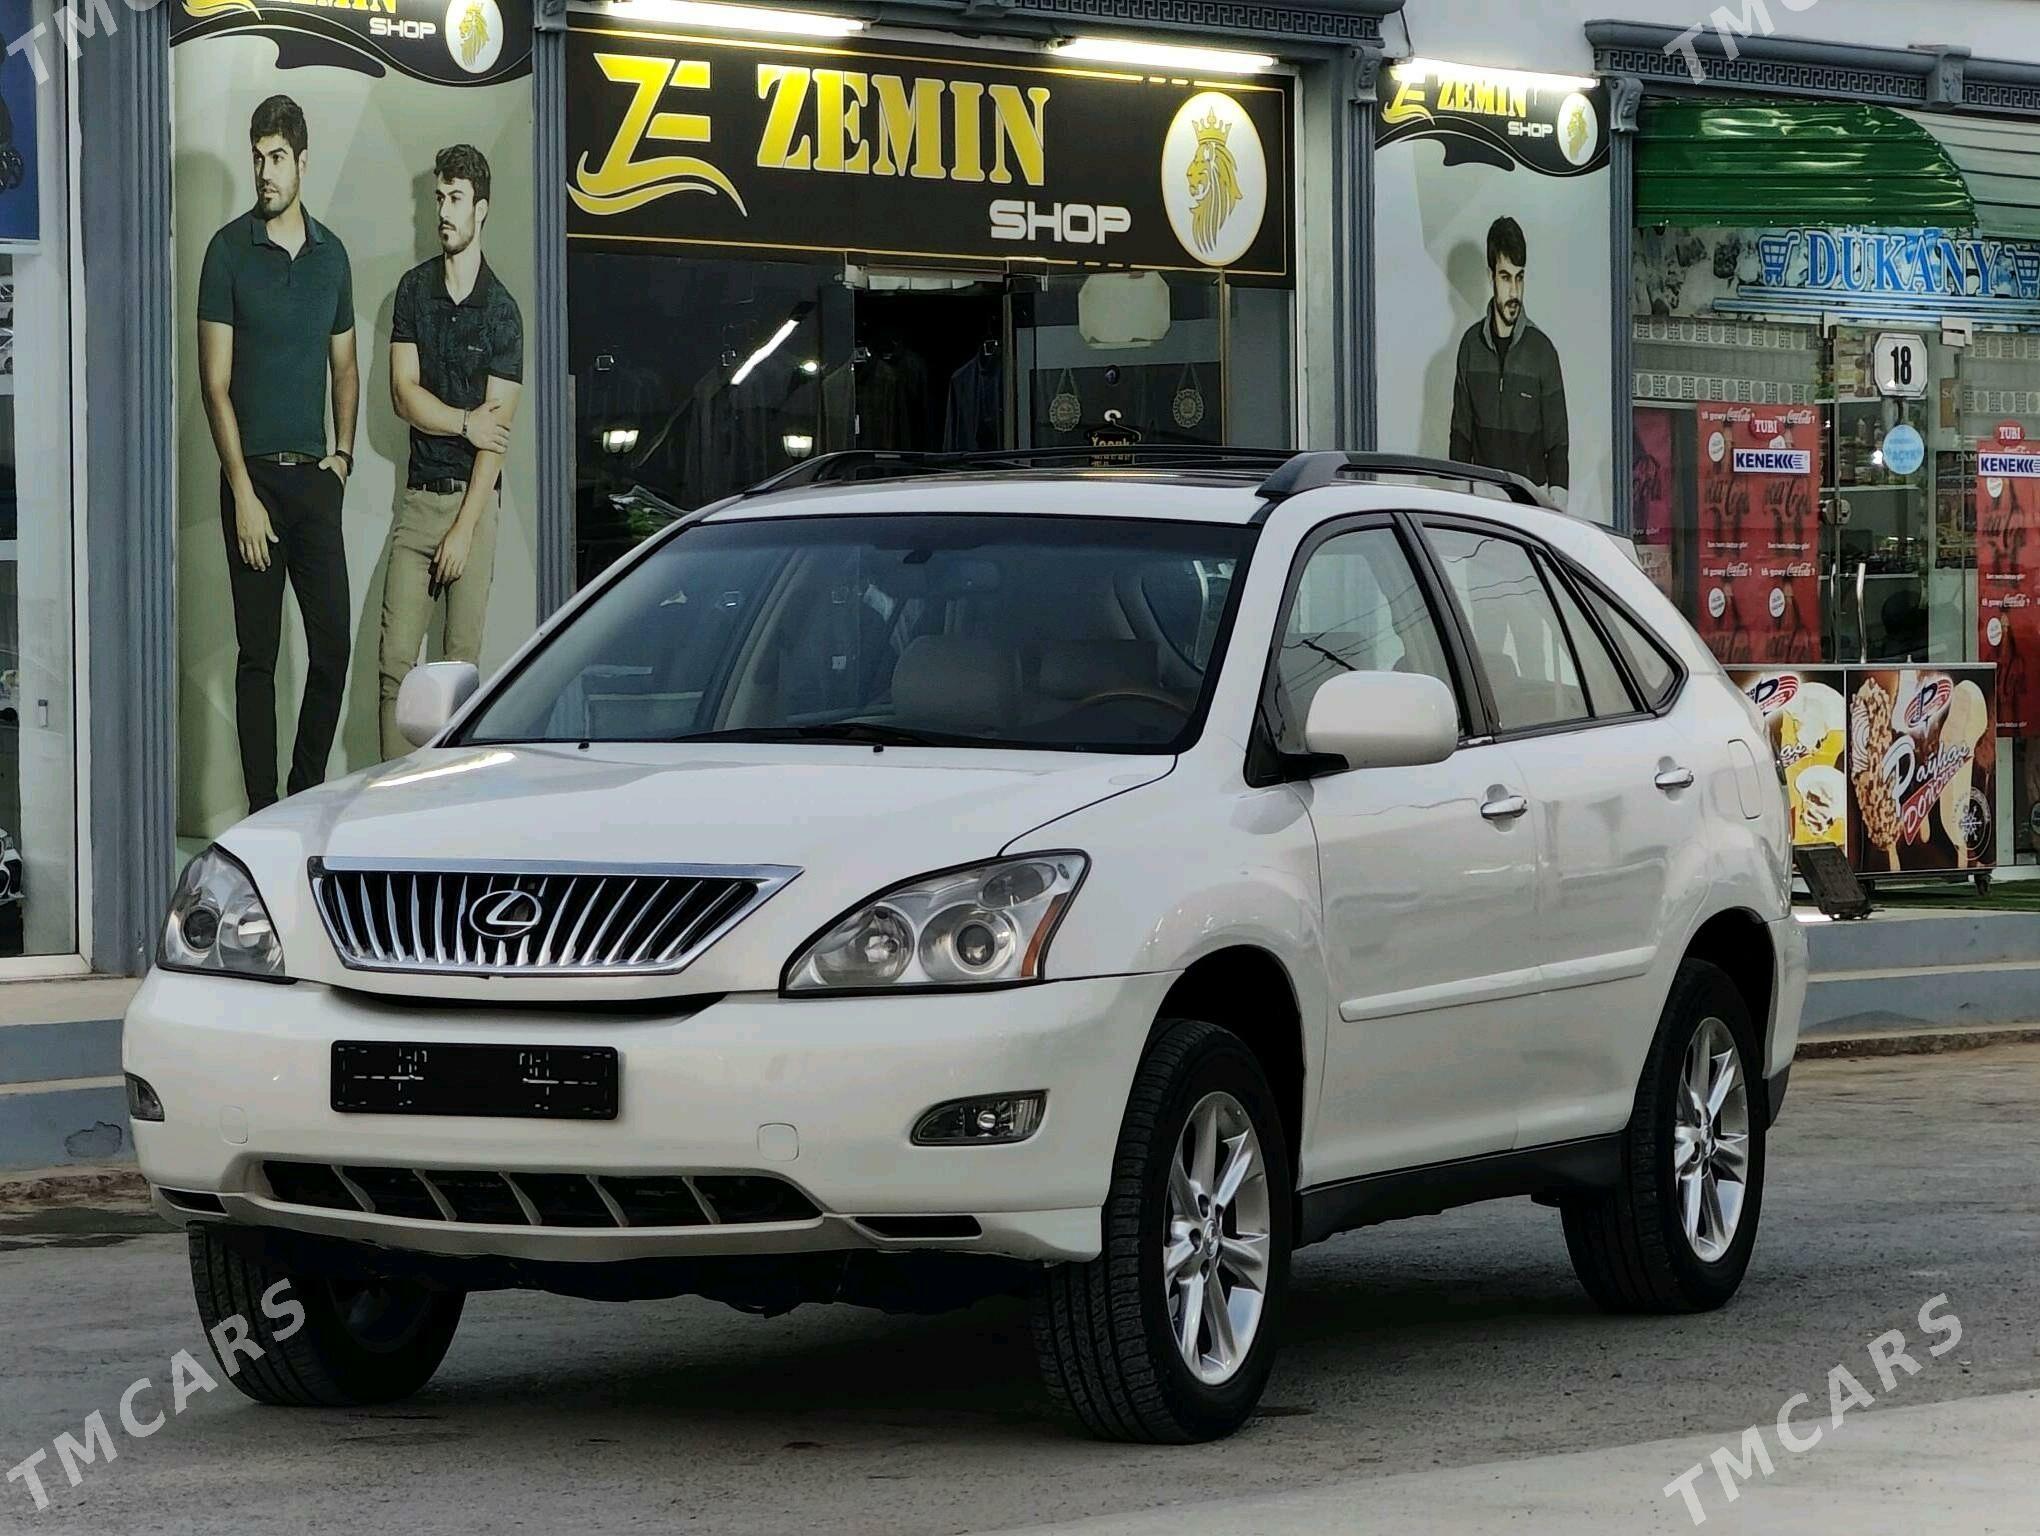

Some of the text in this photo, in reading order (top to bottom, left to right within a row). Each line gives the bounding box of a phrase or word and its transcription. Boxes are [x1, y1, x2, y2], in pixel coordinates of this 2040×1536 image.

[369, 17, 436, 39] SHOP
[1437, 79, 1526, 117] ZEMIN
[757, 64, 1050, 186] ZEMIN
[1508, 121, 1553, 137] SHOP
[990, 199, 1131, 244] SHOP
[1890, 345, 1911, 385] 18
[1754, 420, 1778, 433] TUBI
[1999, 427, 2021, 439] TUBI
